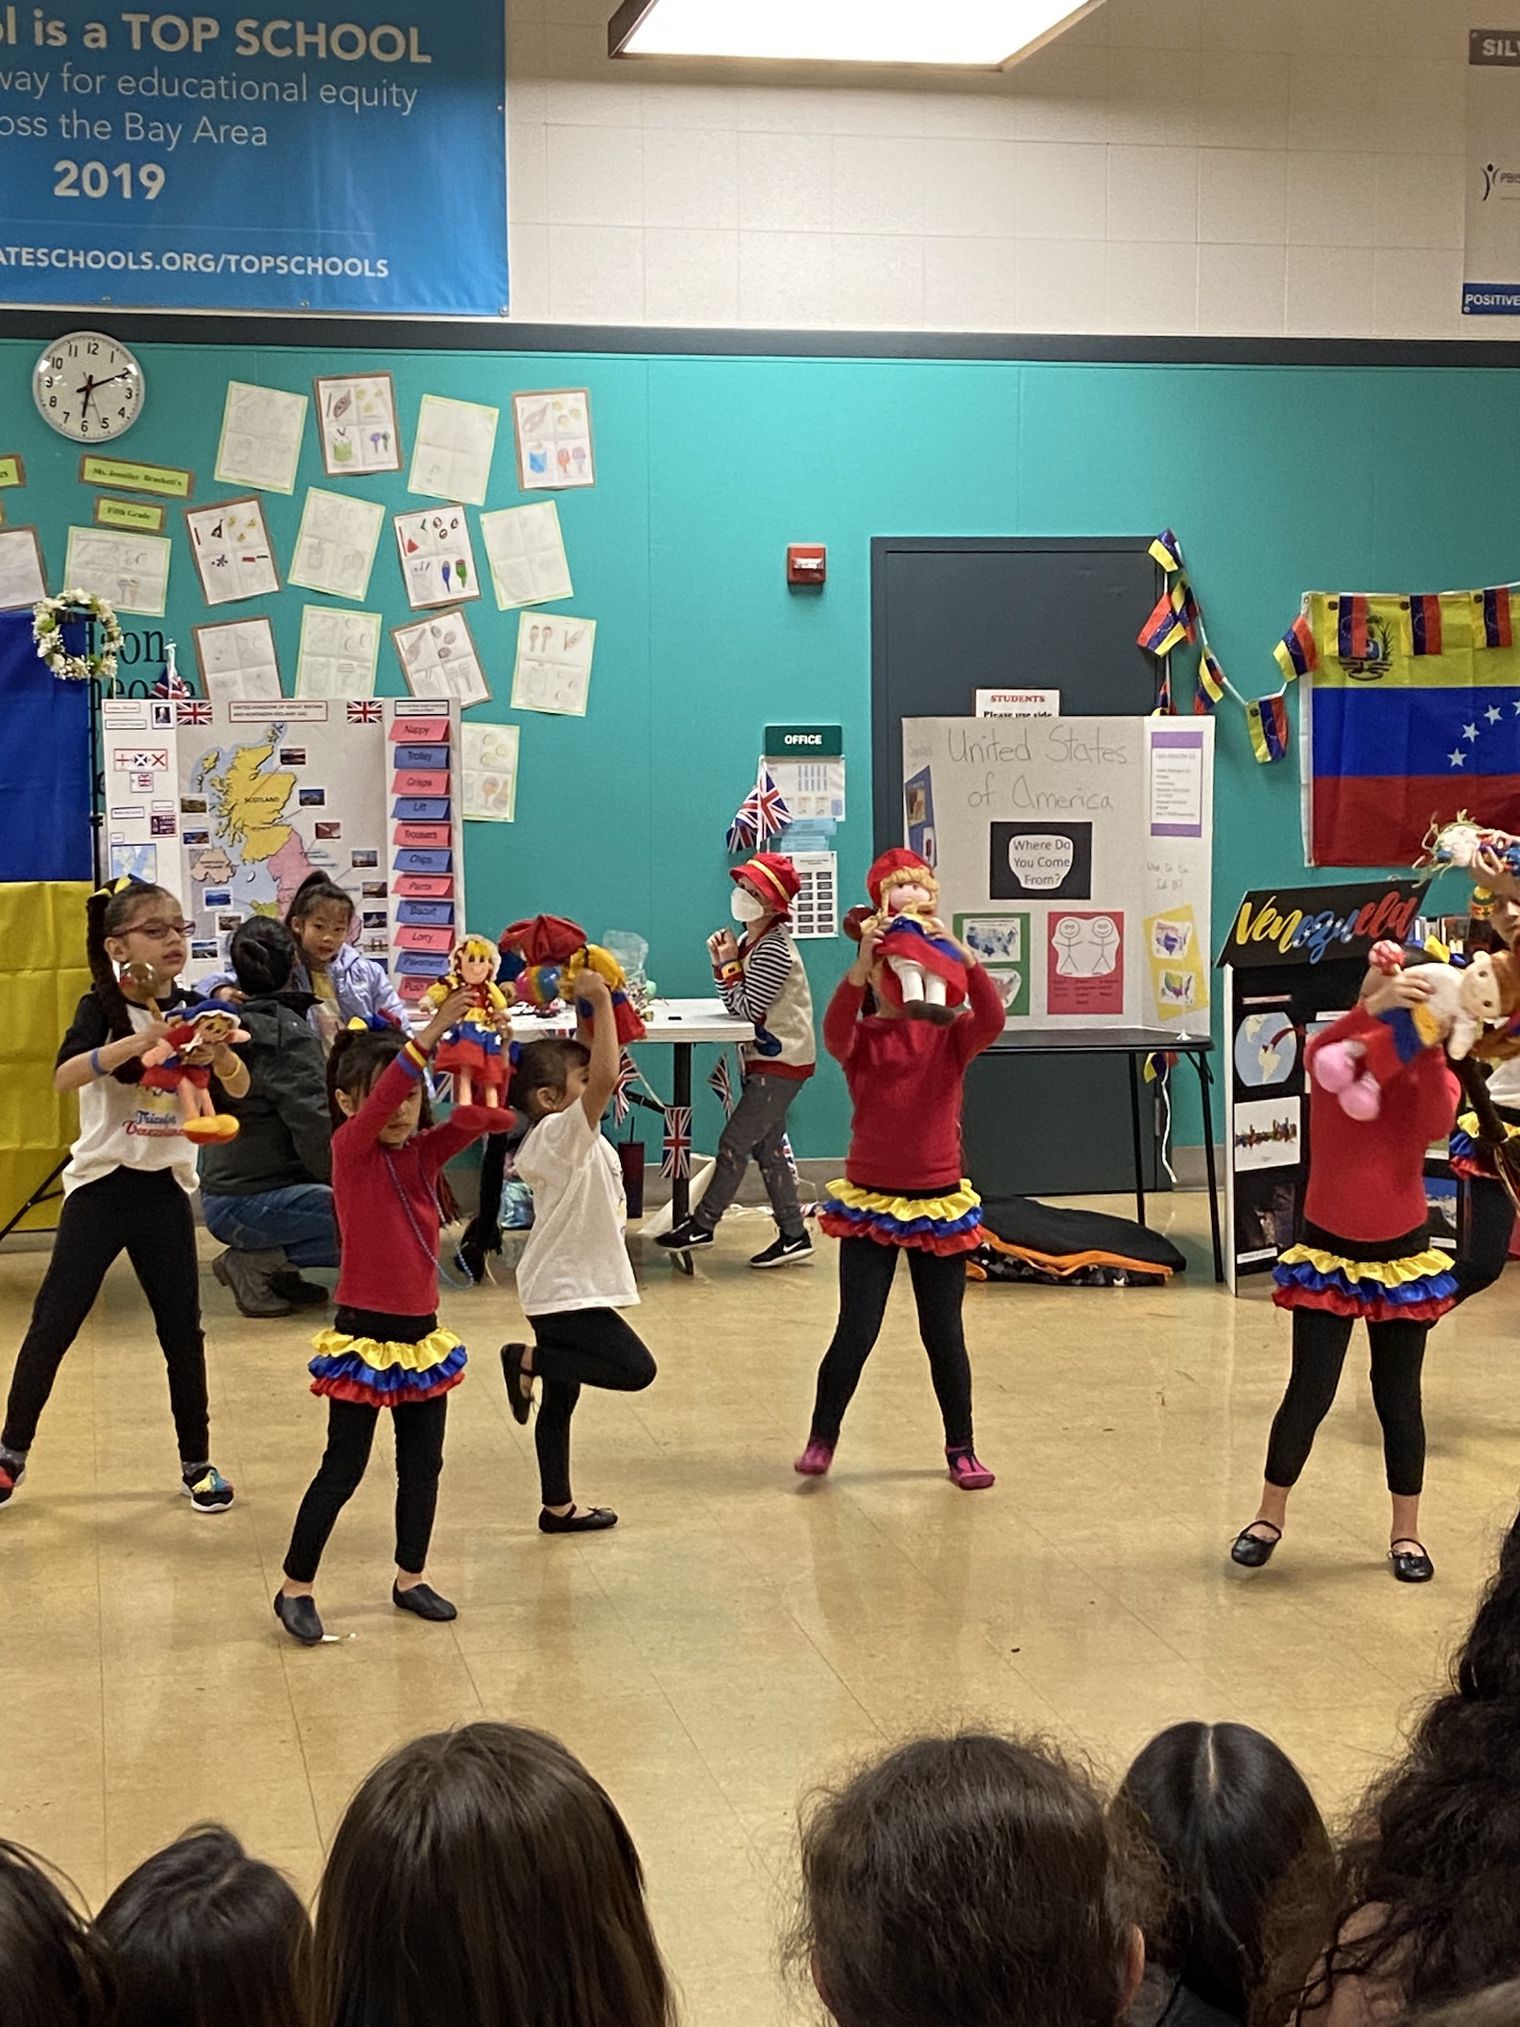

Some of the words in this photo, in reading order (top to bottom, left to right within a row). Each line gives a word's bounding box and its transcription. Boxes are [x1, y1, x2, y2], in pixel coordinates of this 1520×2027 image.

[34, 8, 67, 46] is
[83, 22, 107, 48] a
[122, 13, 220, 52] TOP
[235, 19, 431, 63] SCHOOL
[1483, 39, 1520, 56] SIL
[60, 61, 106, 94] for
[118, 67, 307, 102] educational
[320, 77, 418, 116] equity
[60, 110, 112, 139] the
[125, 114, 182, 150] Bay
[193, 116, 267, 145] Area
[54, 160, 166, 199] 2019
[87, 342, 99, 355] 12
[52, 357, 63, 369] 10
[125, 387, 133, 399] 3
[49, 396, 57, 408] 8
[63, 411, 70, 423] 7
[118, 406, 125, 418] 4
[81, 420, 88, 432] 6
[101, 417, 109, 429] 5
[785, 735, 822, 744] OFFICE
[949, 729, 1031, 764] United
[1045, 725, 1128, 764] States
[408, 751, 432, 762] Trolley
[968, 772, 995, 809] of
[1012, 775, 1114, 809] America
[1013, 840, 1051, 851] Where
[1055, 839, 1071, 850] Do
[1013, 857, 1034, 868] You
[1037, 856, 1070, 868] Come
[1024, 873, 1061, 885] From?
[1236, 888, 1418, 965] Venezuela
[412, 932, 433, 943] Lorry
